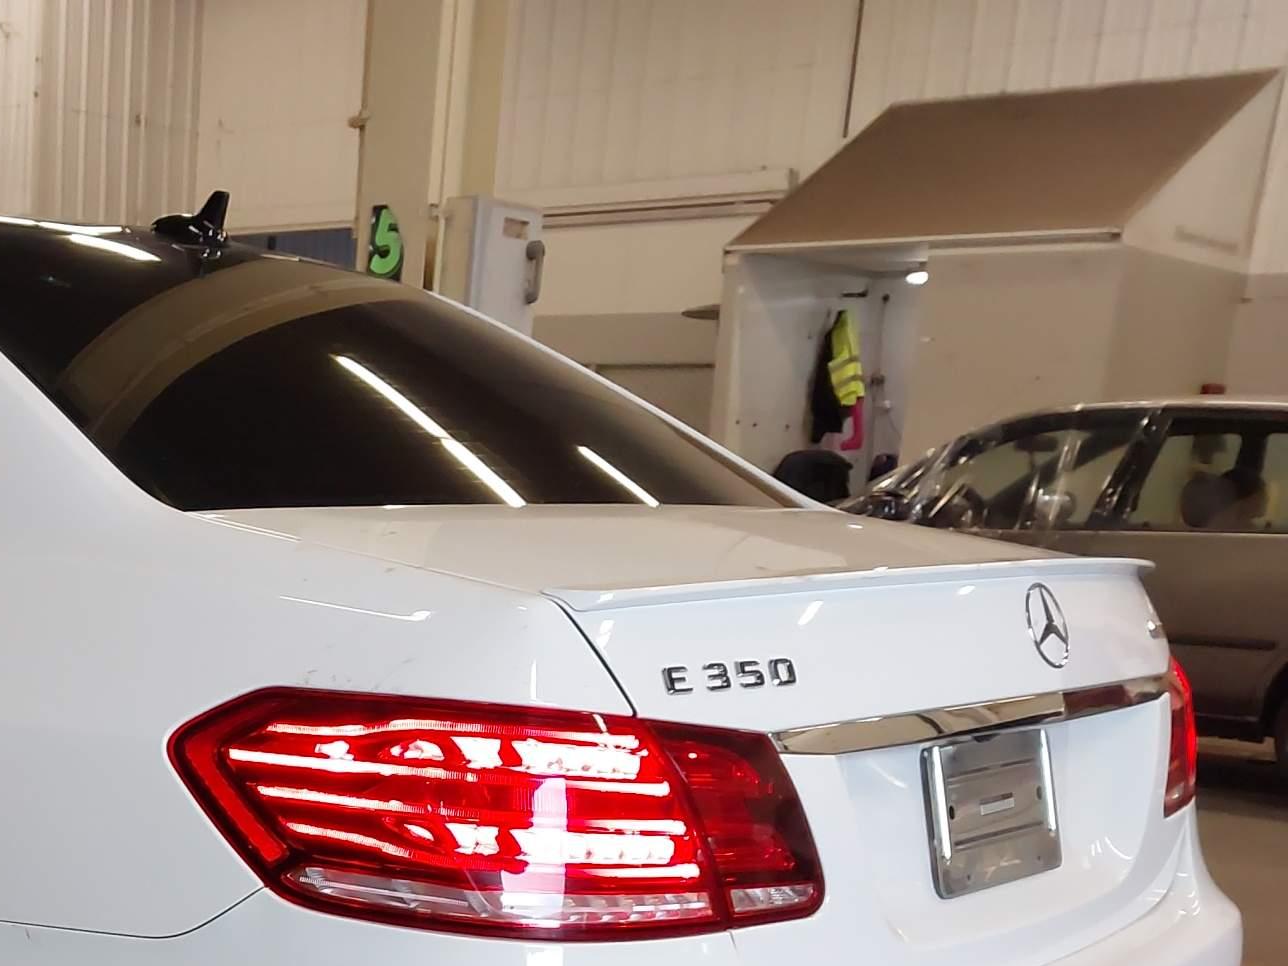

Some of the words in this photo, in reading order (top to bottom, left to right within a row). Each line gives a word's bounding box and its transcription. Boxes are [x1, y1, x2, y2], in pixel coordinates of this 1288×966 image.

[369, 207, 402, 275] 5
[662, 666, 693, 695] E
[702, 658, 796, 691] 350
